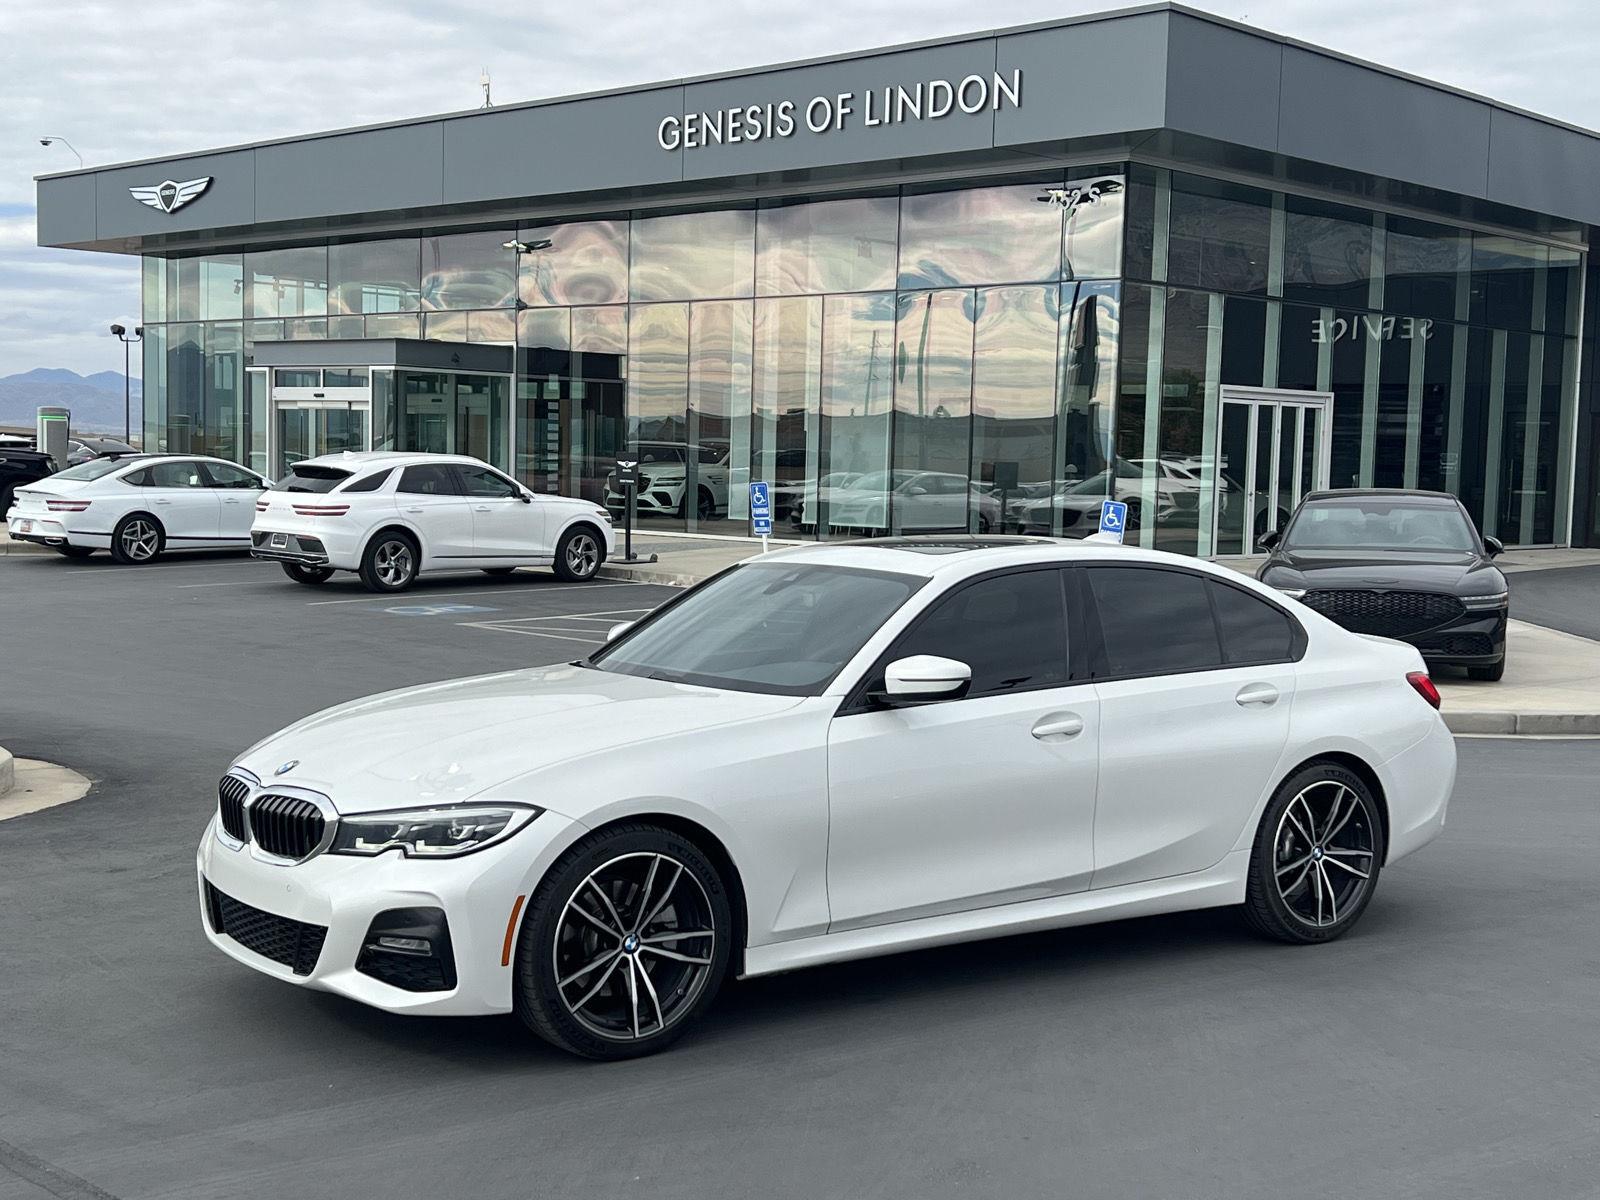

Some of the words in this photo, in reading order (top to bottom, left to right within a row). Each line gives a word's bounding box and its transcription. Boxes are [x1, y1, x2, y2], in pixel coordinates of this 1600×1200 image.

[658, 100, 796, 151] GENESIS
[805, 92, 854, 134] OF
[865, 69, 1023, 126] LINDON
